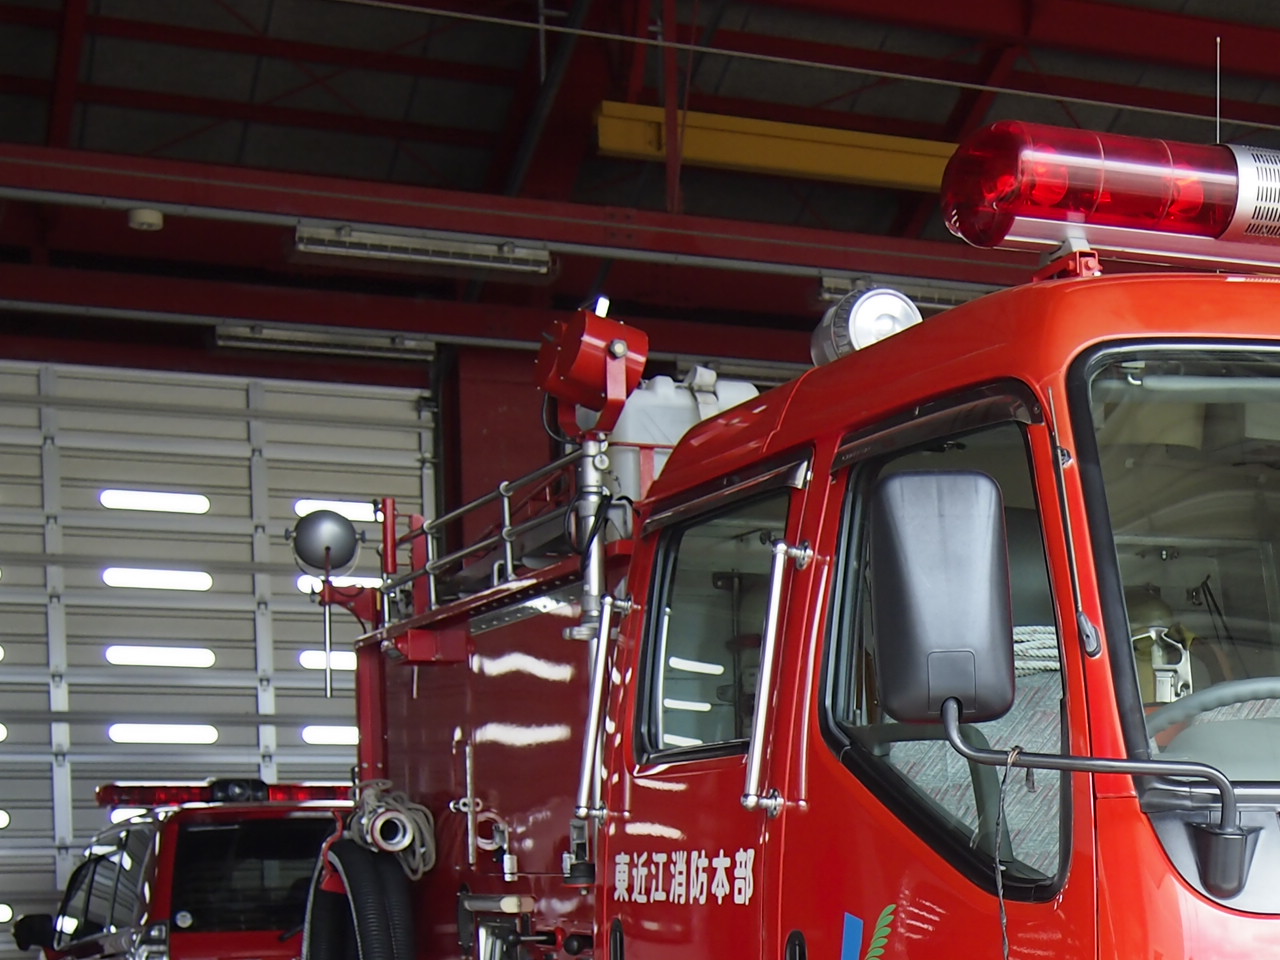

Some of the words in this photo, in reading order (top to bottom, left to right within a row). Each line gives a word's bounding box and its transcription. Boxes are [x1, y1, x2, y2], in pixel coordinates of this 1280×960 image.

[613, 848, 756, 906] 東近江消防本部
